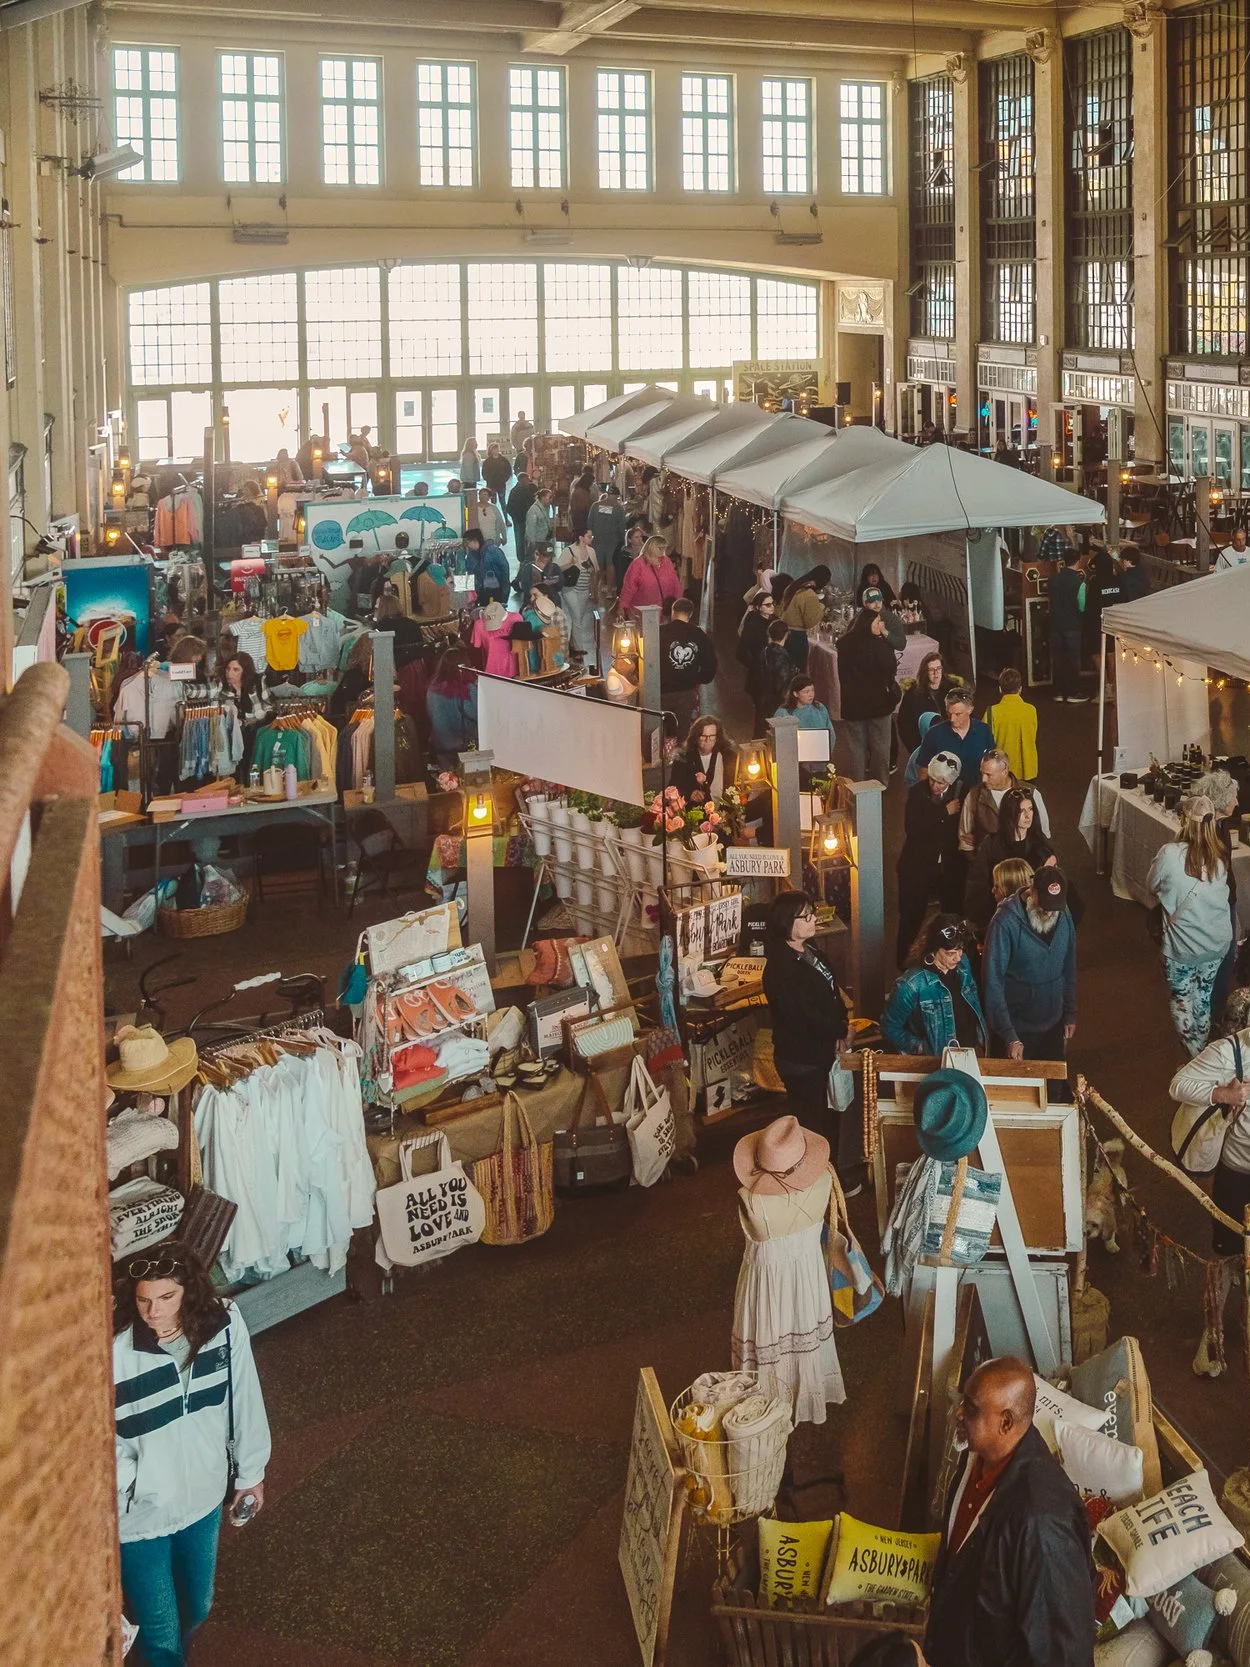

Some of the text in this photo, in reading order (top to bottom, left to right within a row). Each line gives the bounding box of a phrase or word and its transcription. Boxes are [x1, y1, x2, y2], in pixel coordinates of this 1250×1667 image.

[743, 361, 812, 372] SPACE STATION
[730, 860, 785, 874] ASBURY PARK
[726, 962, 763, 971] PICKLEBALL
[406, 1177, 467, 1210] ALL YOU
[135, 1204, 178, 1225] ALRIGHT
[407, 1193, 467, 1223] NEED IS
[133, 1224, 152, 1238] THE
[409, 1208, 469, 1242] LOVE AND
[412, 1234, 449, 1254] ASBURY
[1038, 1395, 1063, 1418] mrs.
[1131, 1496, 1180, 1546] IFE
[879, 1535, 913, 1550] NEW JERSEY
[849, 1547, 901, 1577] ASBURY
[864, 1582, 915, 1600] THE GARDEN STATE
